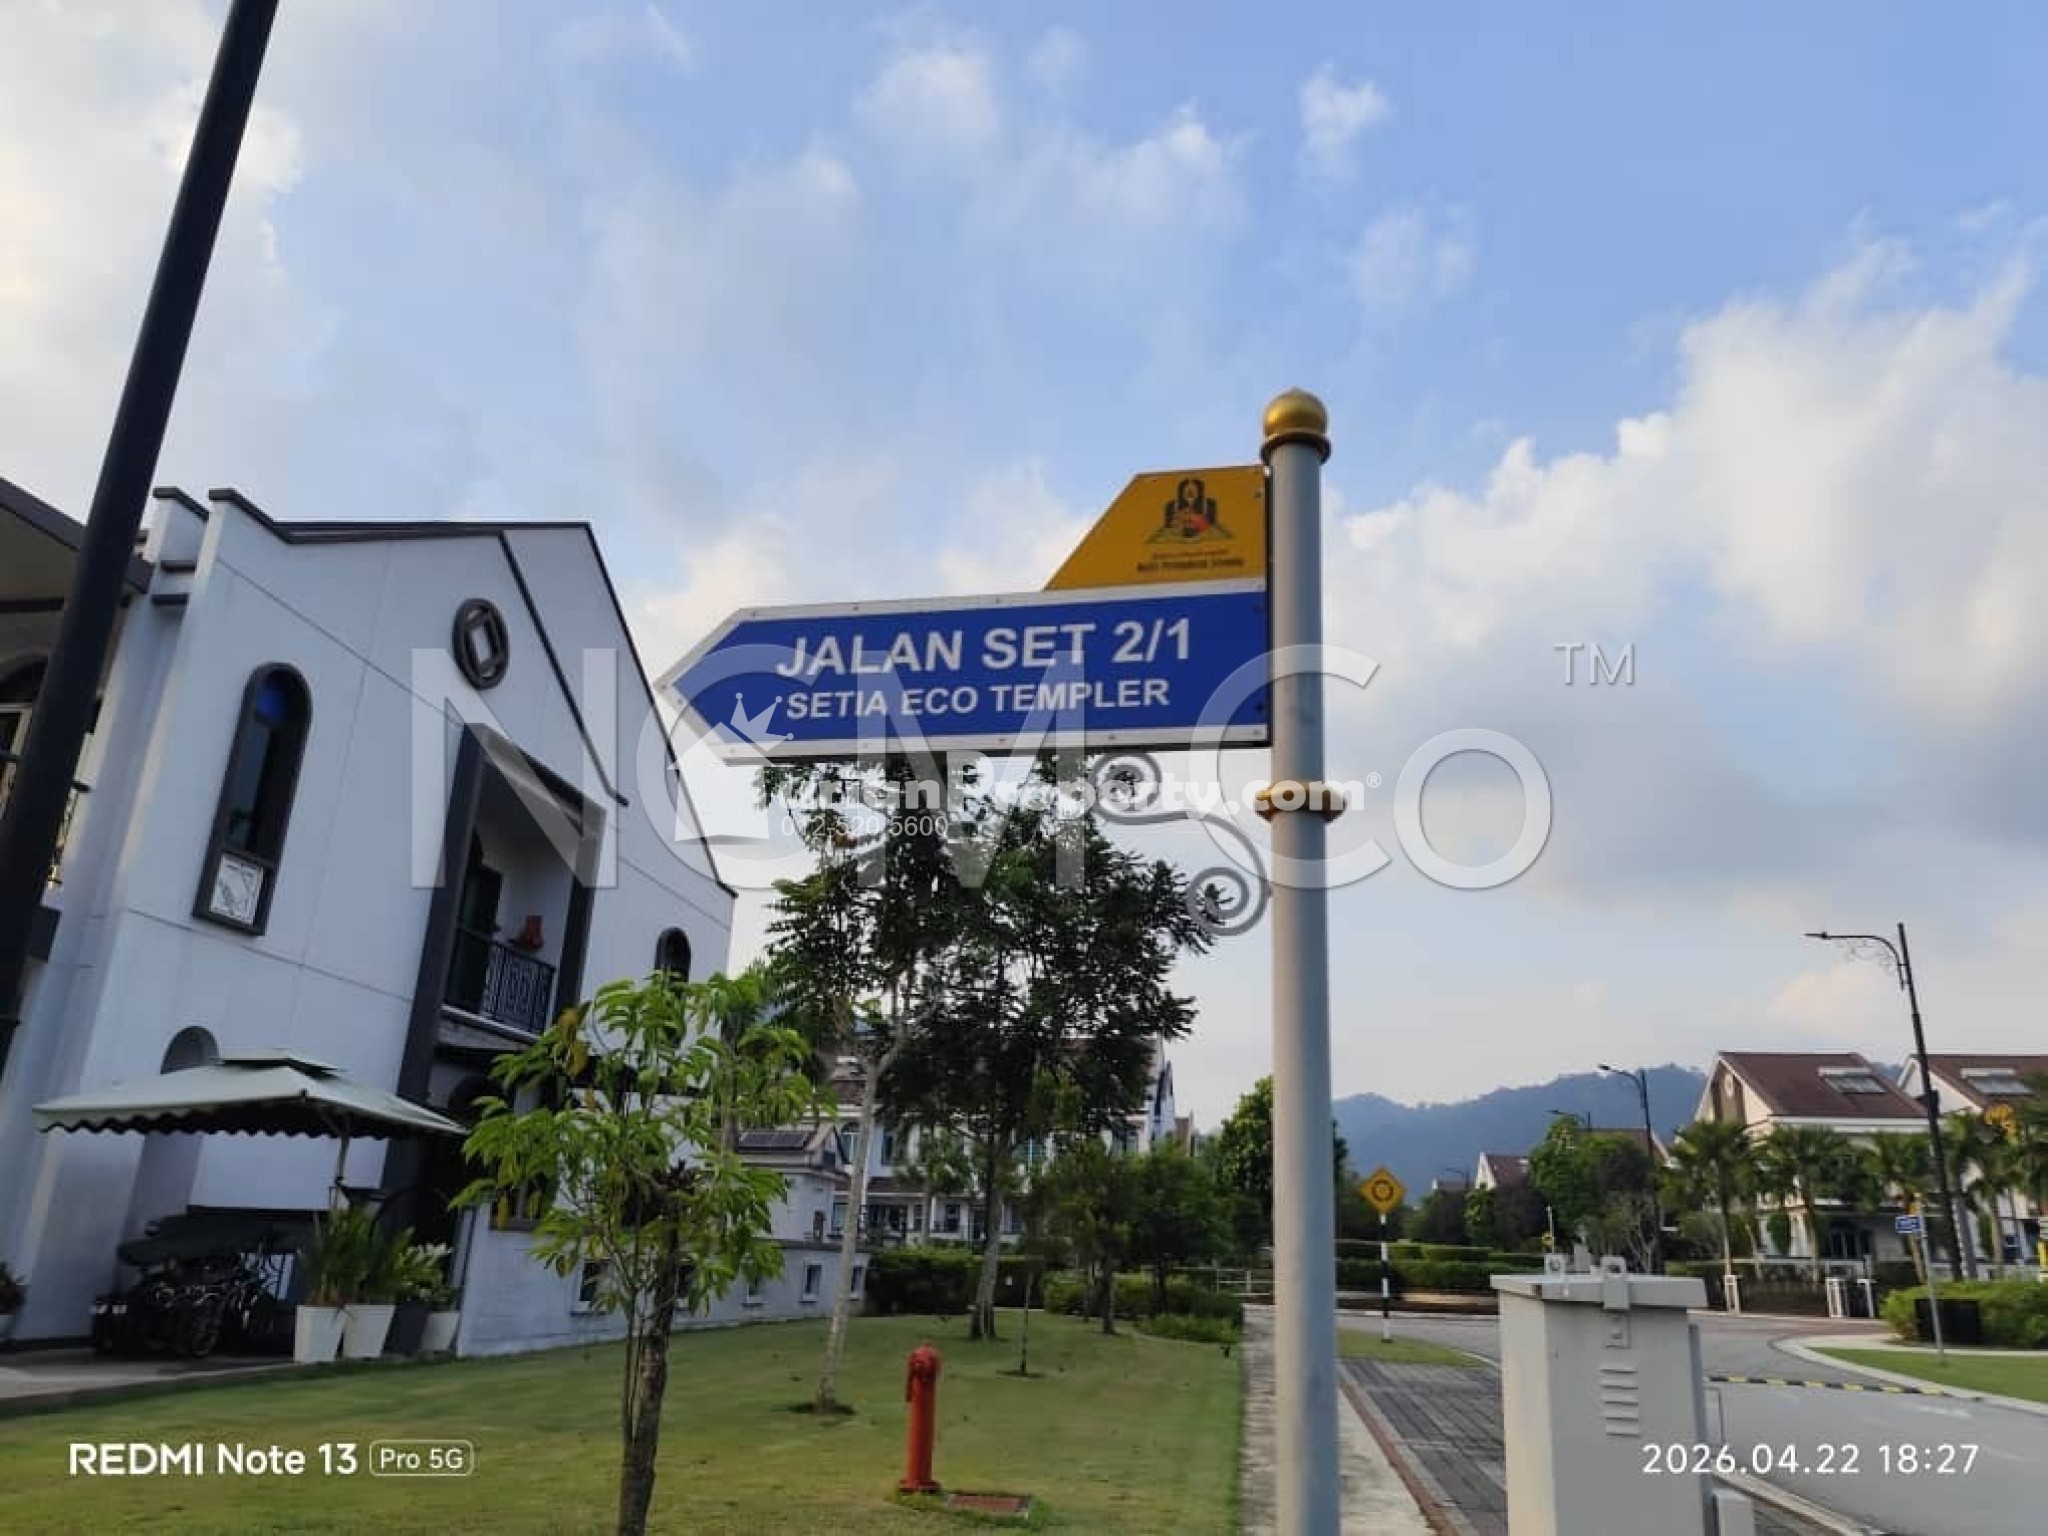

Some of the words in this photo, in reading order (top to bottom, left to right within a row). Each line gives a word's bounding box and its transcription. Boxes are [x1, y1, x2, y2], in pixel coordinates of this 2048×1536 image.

[775, 629, 964, 678] JALAN
[981, 622, 1097, 670] SET
[1111, 617, 1190, 664] 2/1
[786, 690, 888, 720] SETIA
[901, 685, 979, 716] ECO
[989, 677, 1171, 712] TEMPLER
